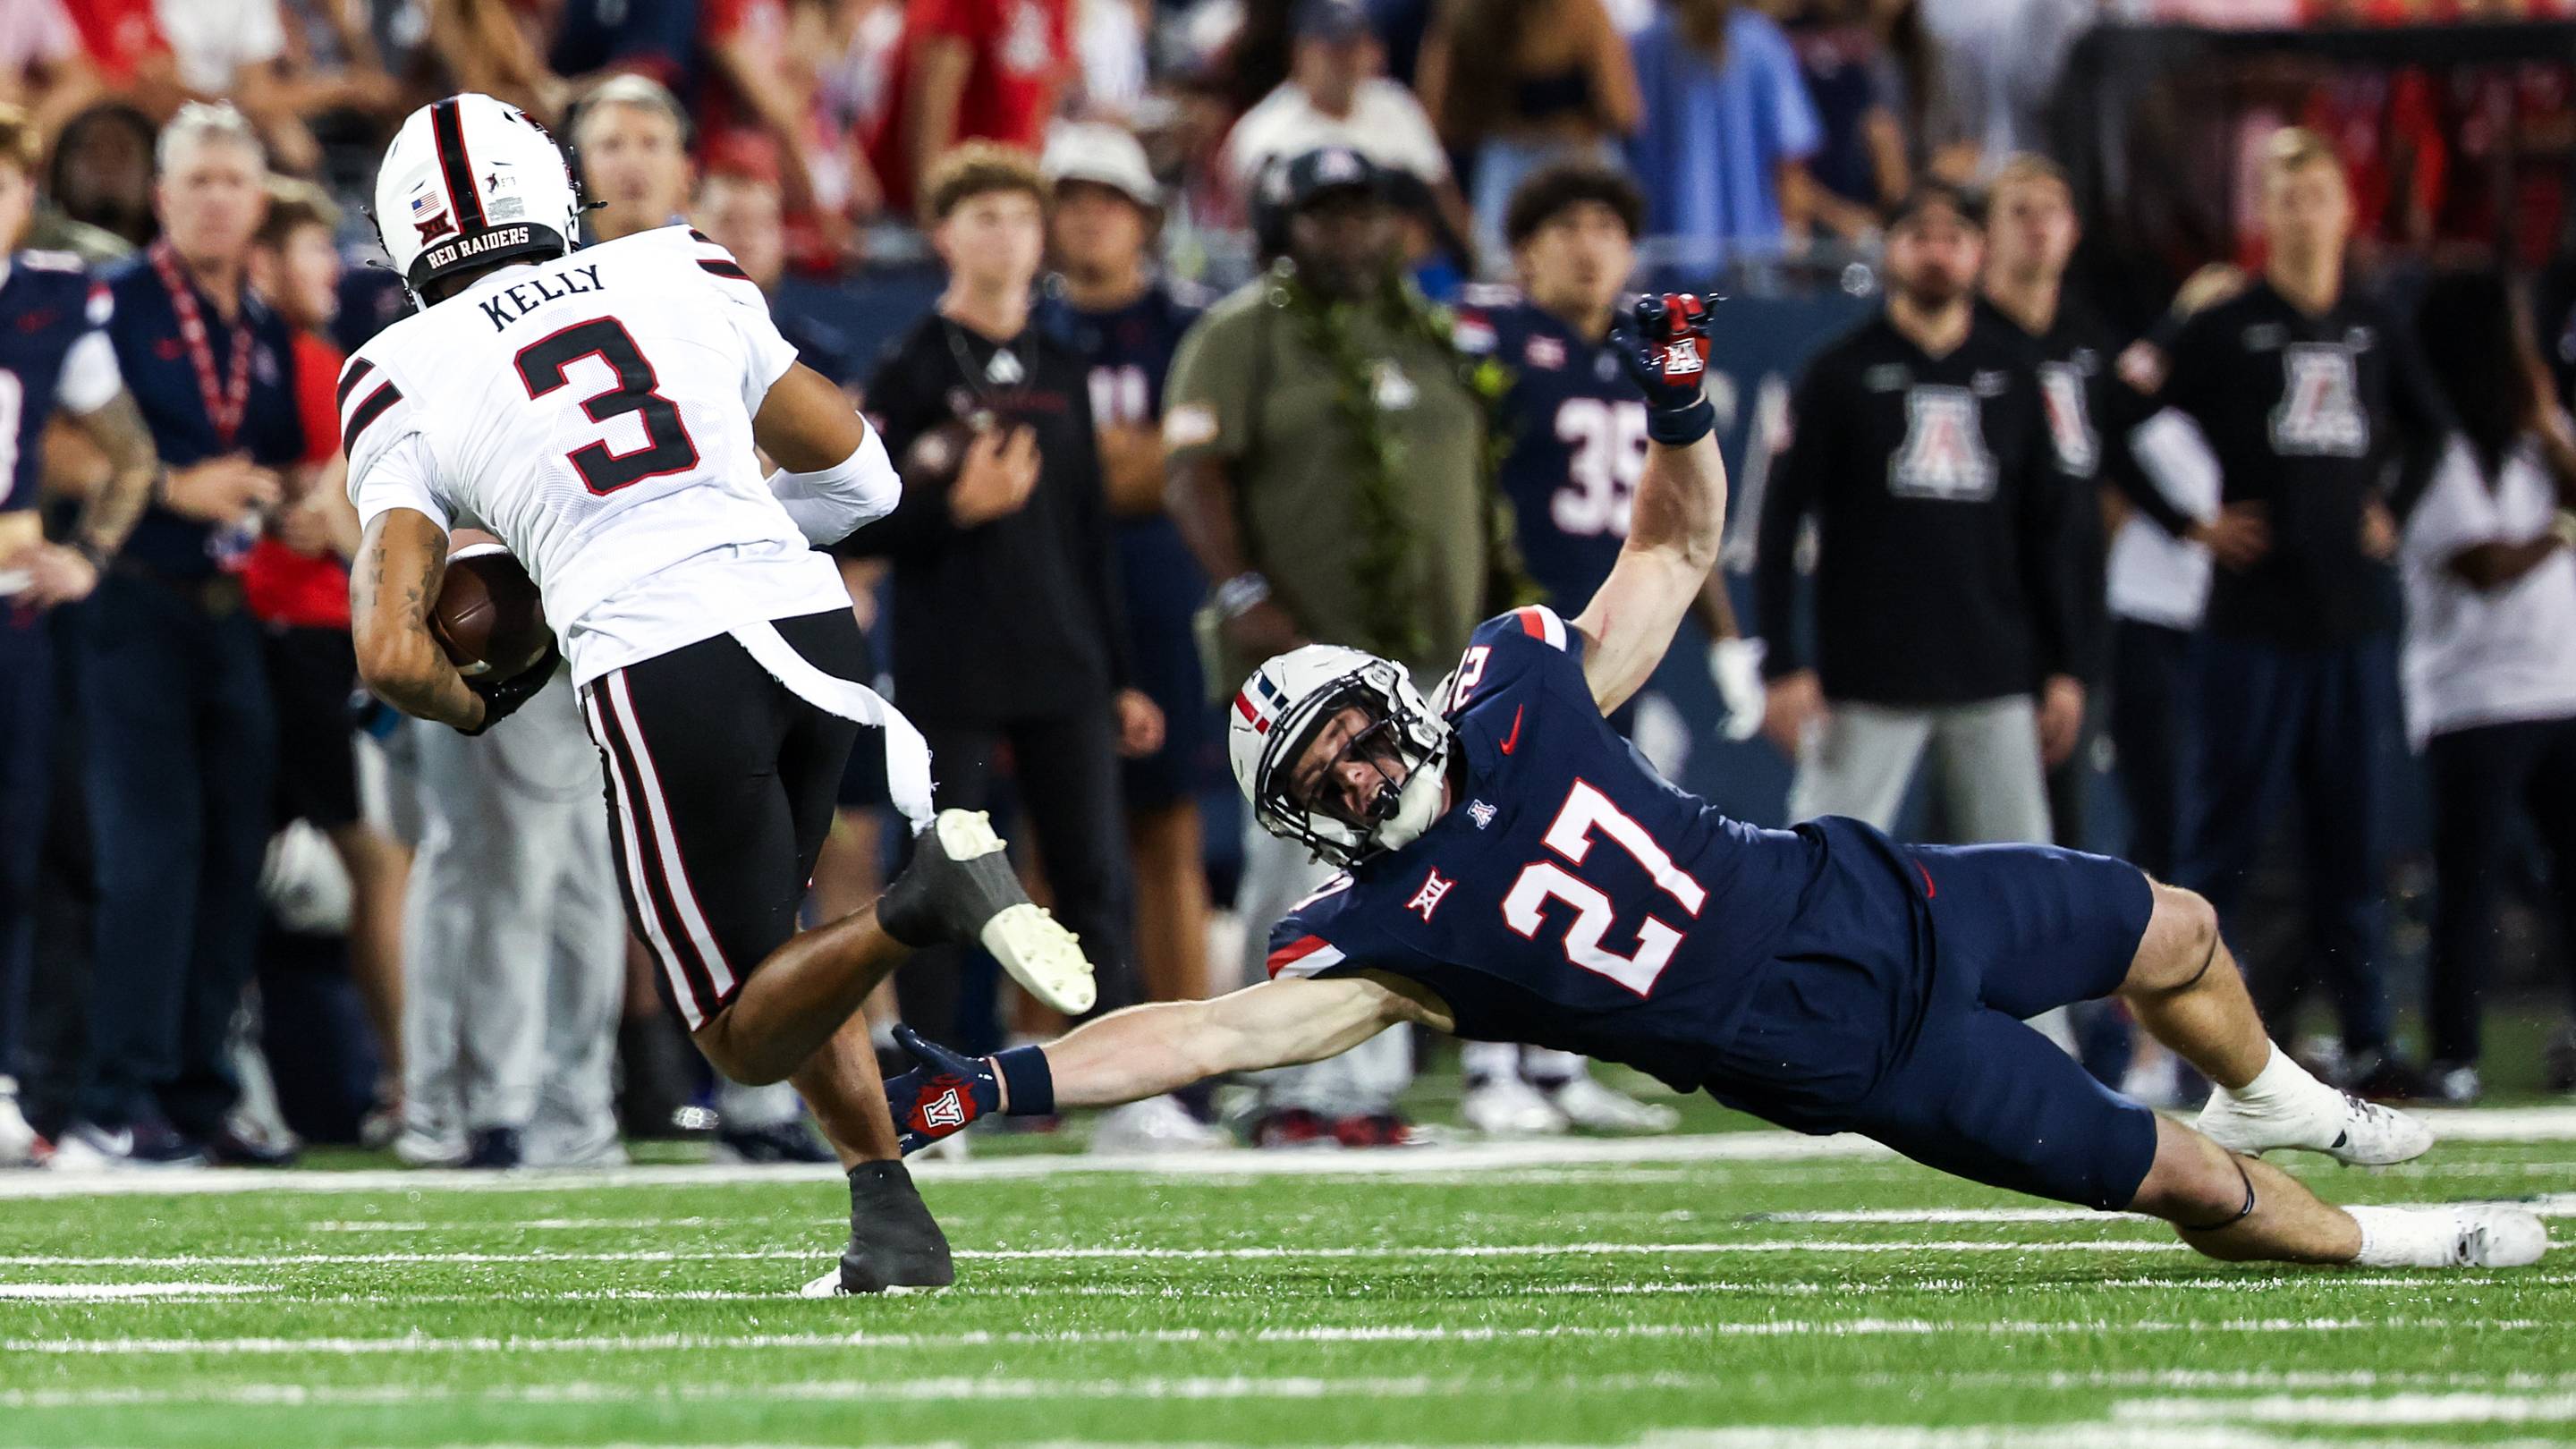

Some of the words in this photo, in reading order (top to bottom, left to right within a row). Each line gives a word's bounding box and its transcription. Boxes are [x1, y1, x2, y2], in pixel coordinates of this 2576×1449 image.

[426, 245, 459, 269] RED
[458, 226, 530, 258] RAIDERS
[479, 265, 605, 333] KELLY
[513, 315, 700, 496] 3
[1467, 799, 1497, 830] A
[1403, 866, 1458, 924] XII
[1500, 776, 1709, 1000] 27
[923, 1088, 965, 1128] A
